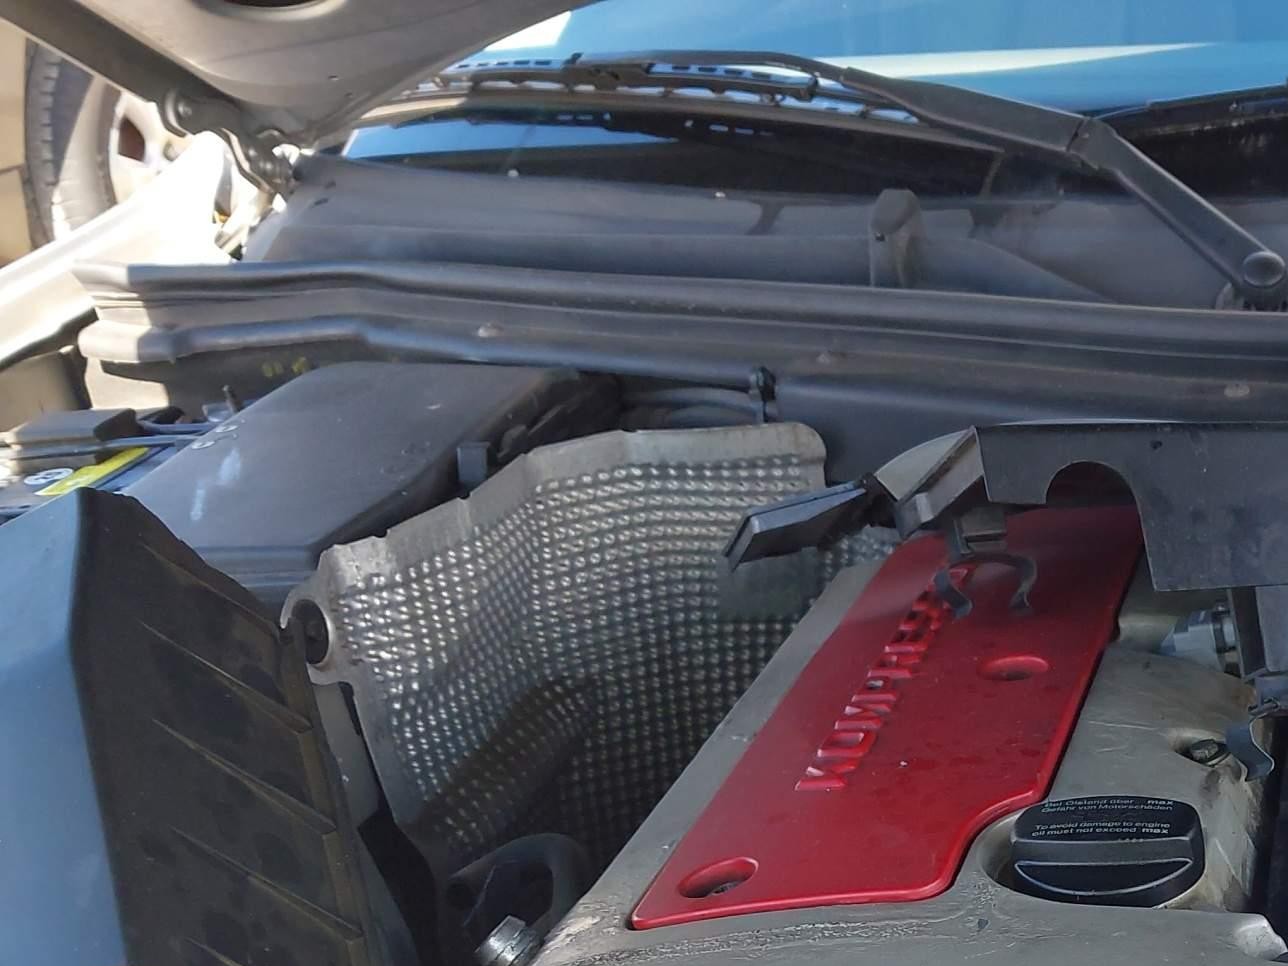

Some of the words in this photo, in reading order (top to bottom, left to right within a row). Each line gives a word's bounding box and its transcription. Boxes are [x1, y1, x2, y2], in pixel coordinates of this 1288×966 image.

[1049, 821, 1079, 830] avoid
[1079, 821, 1122, 829] damage
[1135, 821, 1171, 829] engine
[1031, 829, 1046, 837] oil
[1076, 826, 1094, 834] not
[1141, 827, 1169, 835] max
